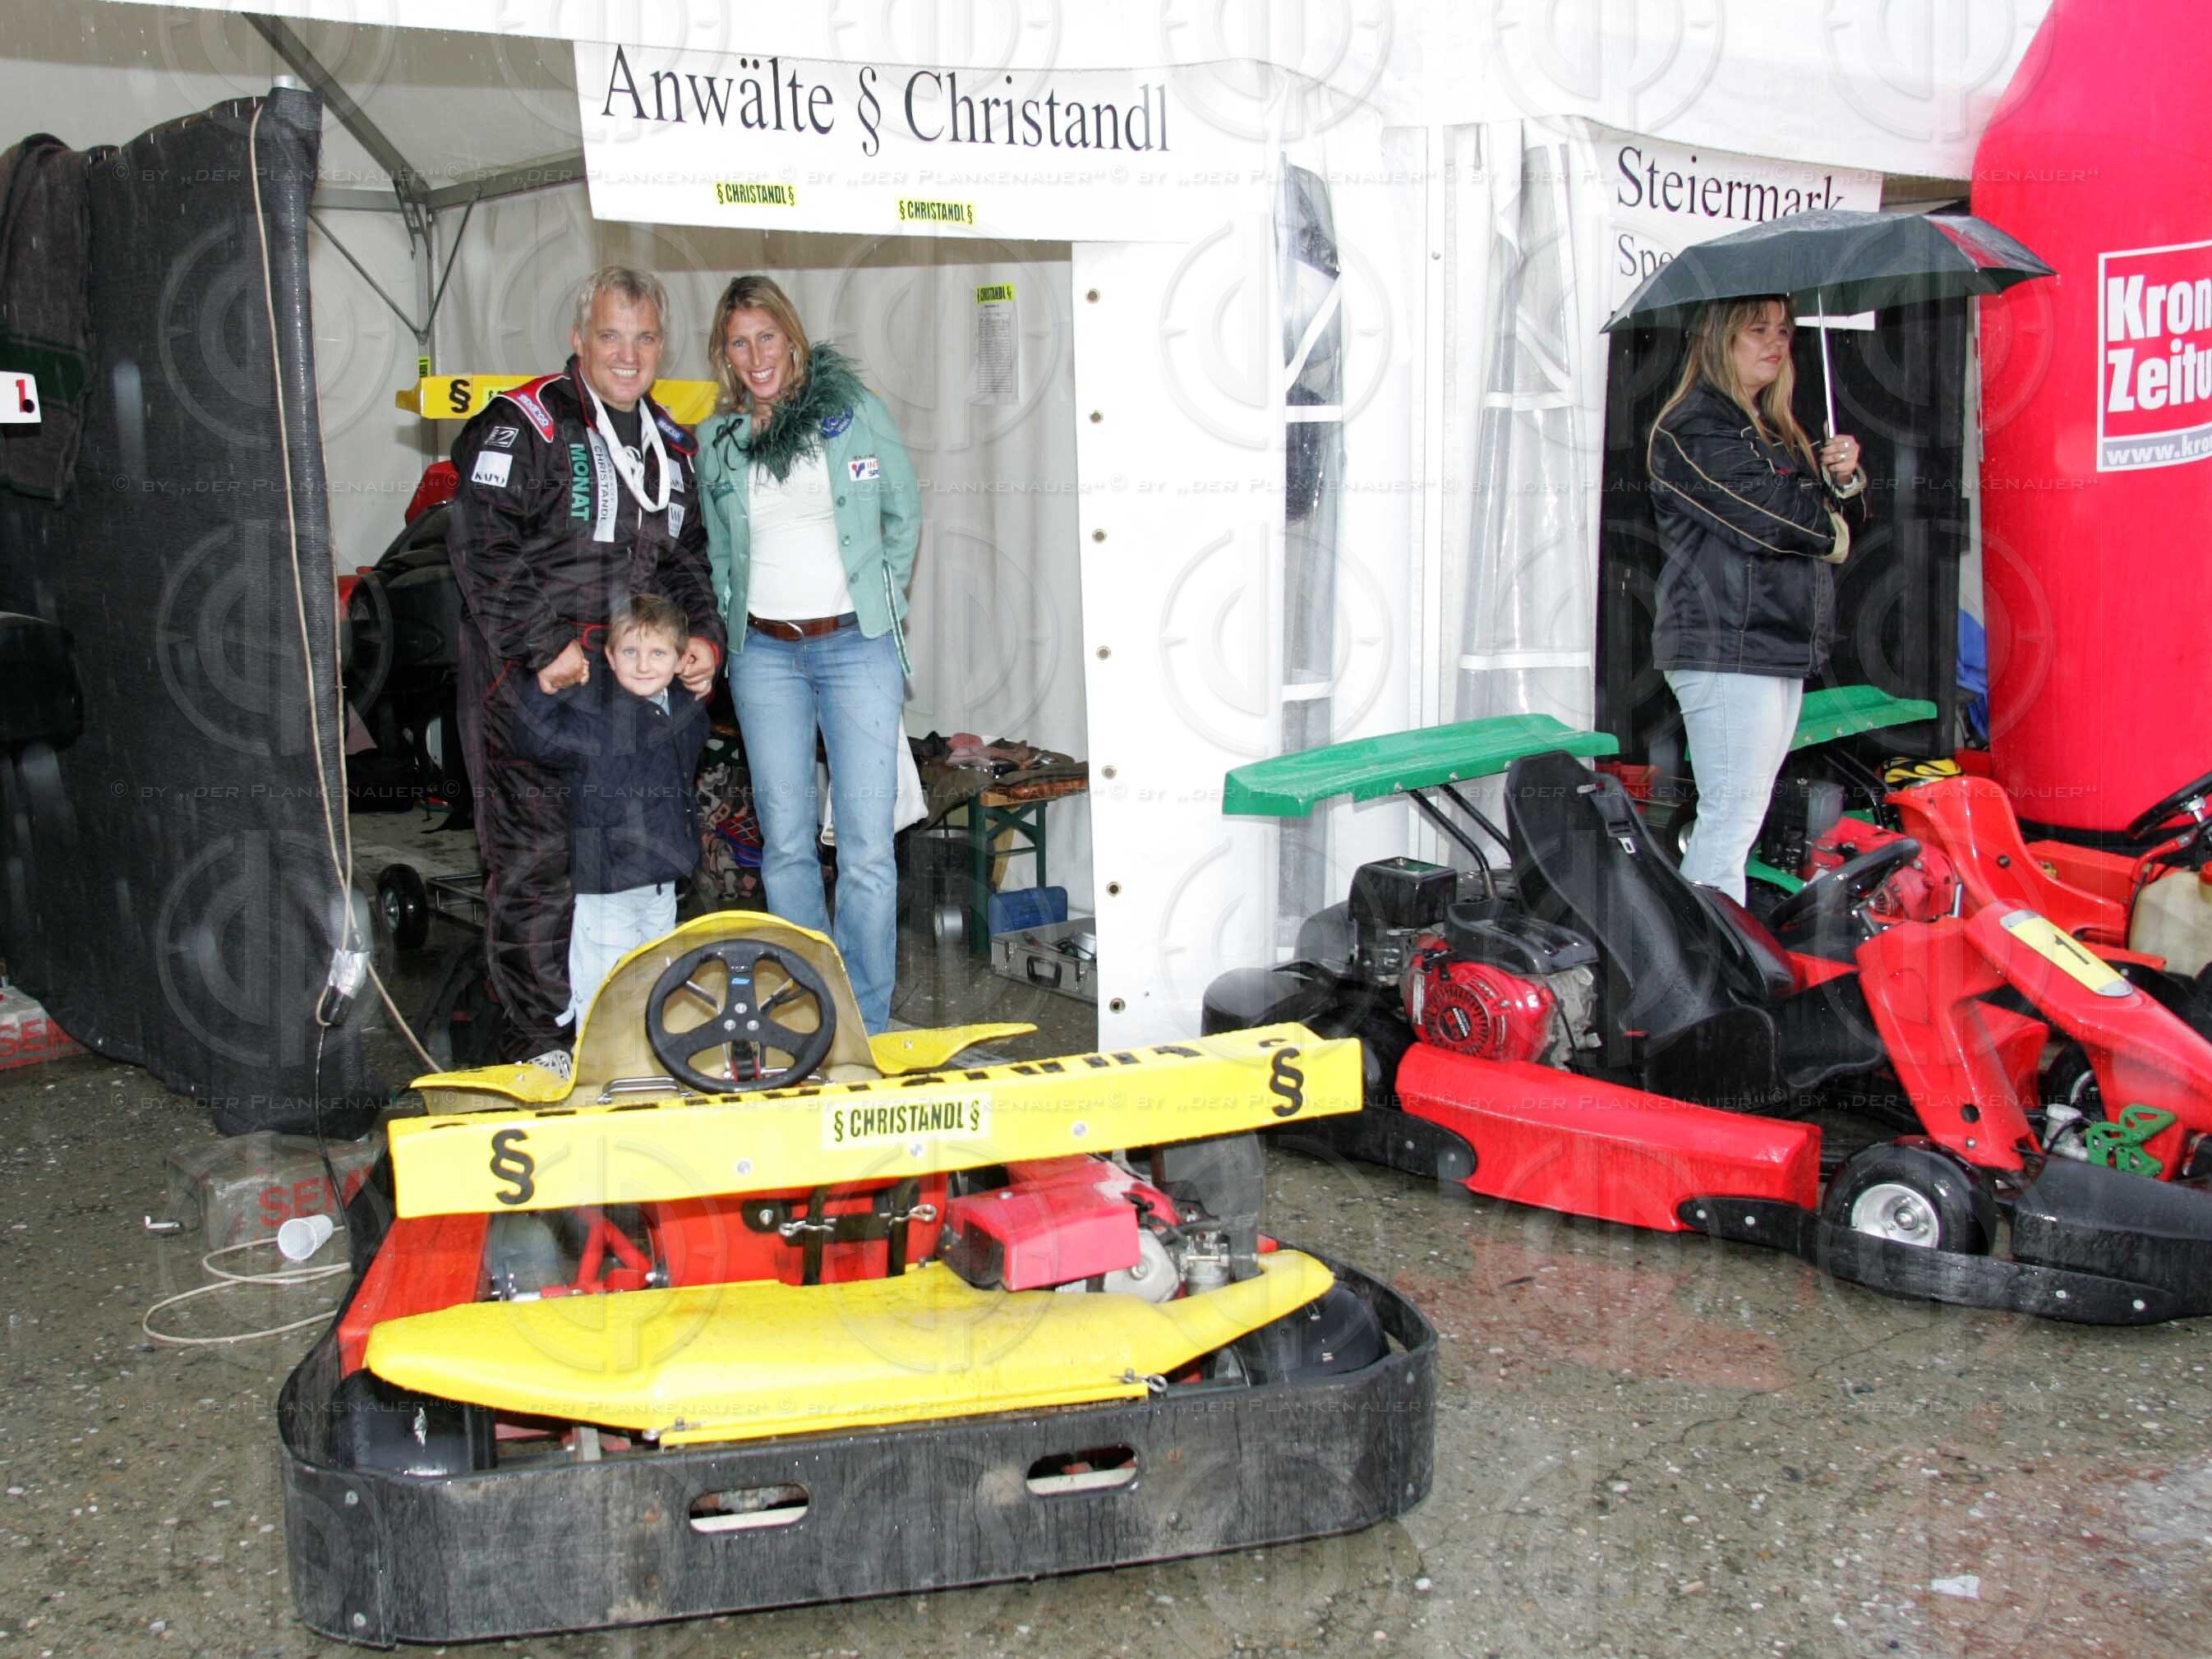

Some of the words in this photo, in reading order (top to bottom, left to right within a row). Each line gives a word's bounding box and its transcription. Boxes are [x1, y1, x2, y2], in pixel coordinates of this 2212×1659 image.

[602, 43, 835, 132] Anwälte
[858, 66, 882, 157] §
[904, 69, 1170, 153] Christandl
[726, 183, 787, 205] CHRISTANDL
[907, 200, 965, 223] CHRISTANDL
[1617, 145, 1845, 222] Steiermark
[2107, 274, 2212, 343] Kron
[449, 379, 472, 413] §
[2107, 338, 2212, 413] Zeitu
[569, 443, 591, 522] MONAT
[2053, 934, 2090, 965] 1
[1267, 1048, 1305, 1118] §
[834, 1110, 844, 1142] §
[850, 1101, 964, 1137] CHRISTANDL
[970, 1099, 979, 1131] §
[488, 1127, 535, 1205] §
